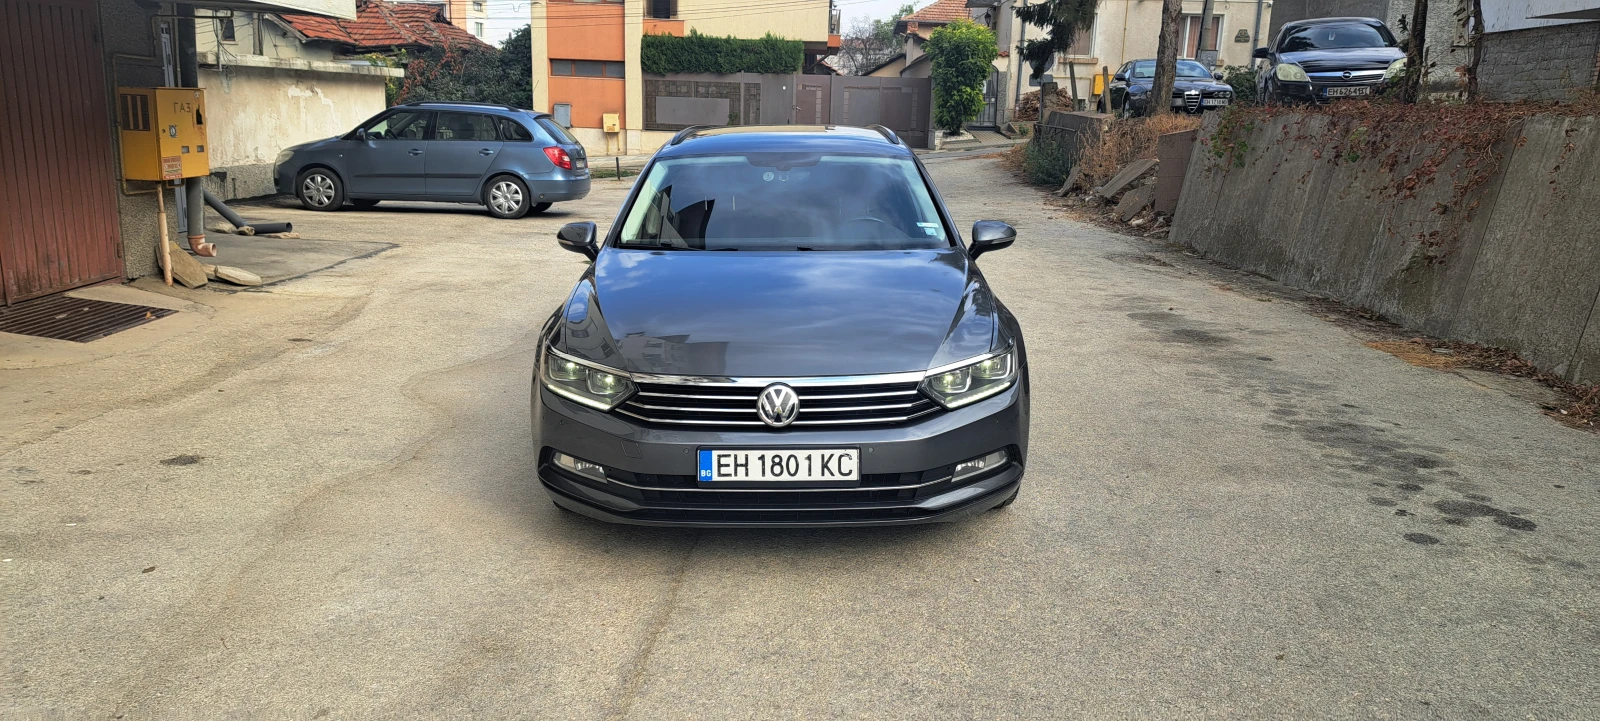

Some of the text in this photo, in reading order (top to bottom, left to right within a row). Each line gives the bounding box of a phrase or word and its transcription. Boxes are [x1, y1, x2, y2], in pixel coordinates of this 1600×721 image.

[174, 102, 191, 114] ГАЗ
[717, 453, 853, 477] EH 1801 KC
[700, 469, 712, 477] BG
